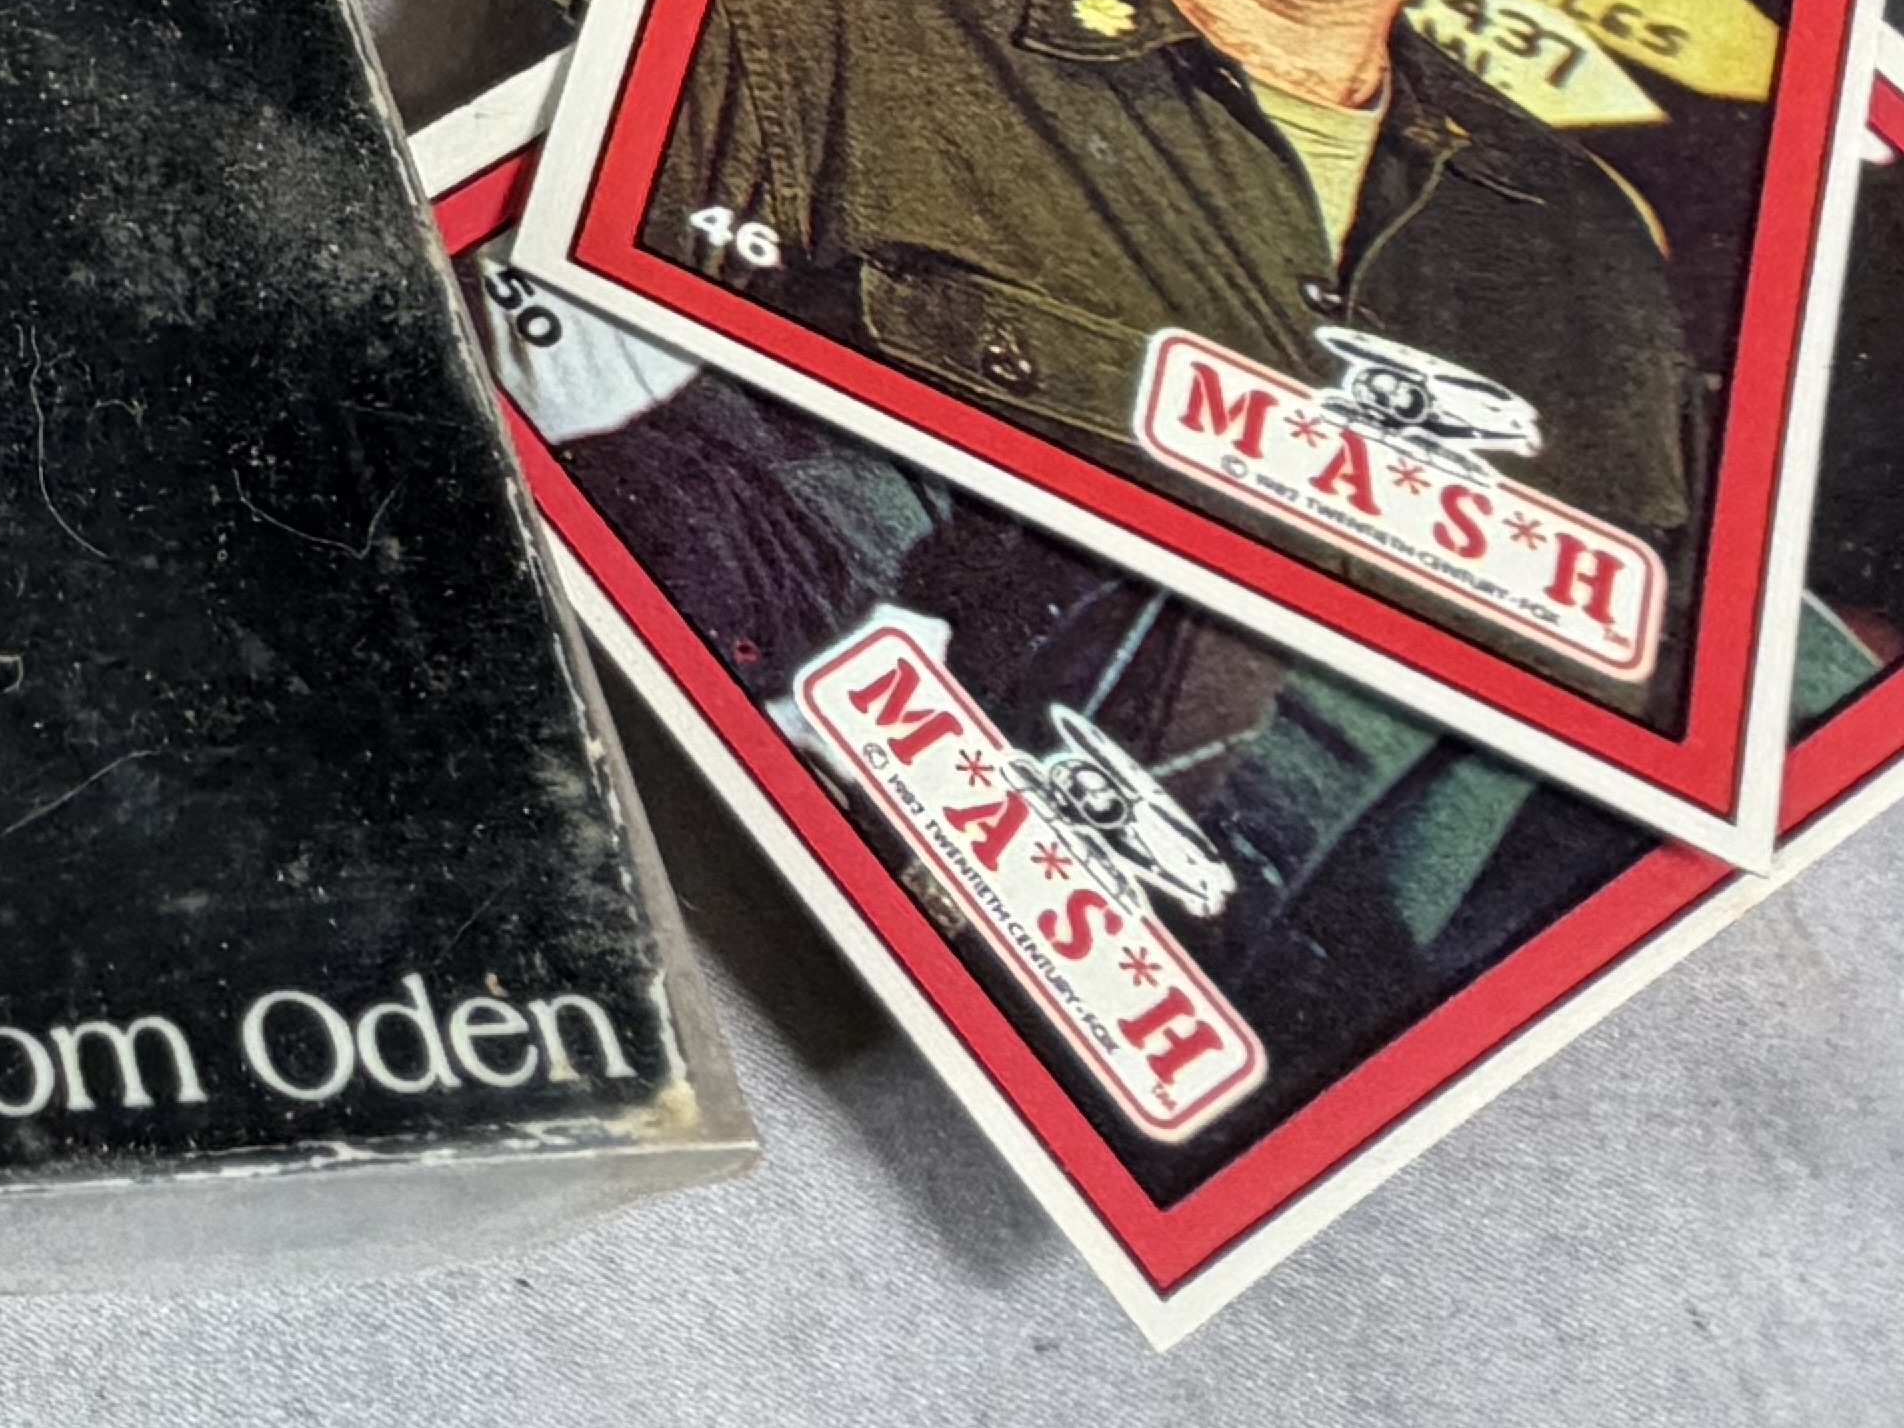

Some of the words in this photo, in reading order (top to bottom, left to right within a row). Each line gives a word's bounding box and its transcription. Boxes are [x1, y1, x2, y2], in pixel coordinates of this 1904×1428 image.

[688, 204, 784, 269] 46
[484, 266, 563, 350] 50
[236, 970, 622, 1101] Oden
